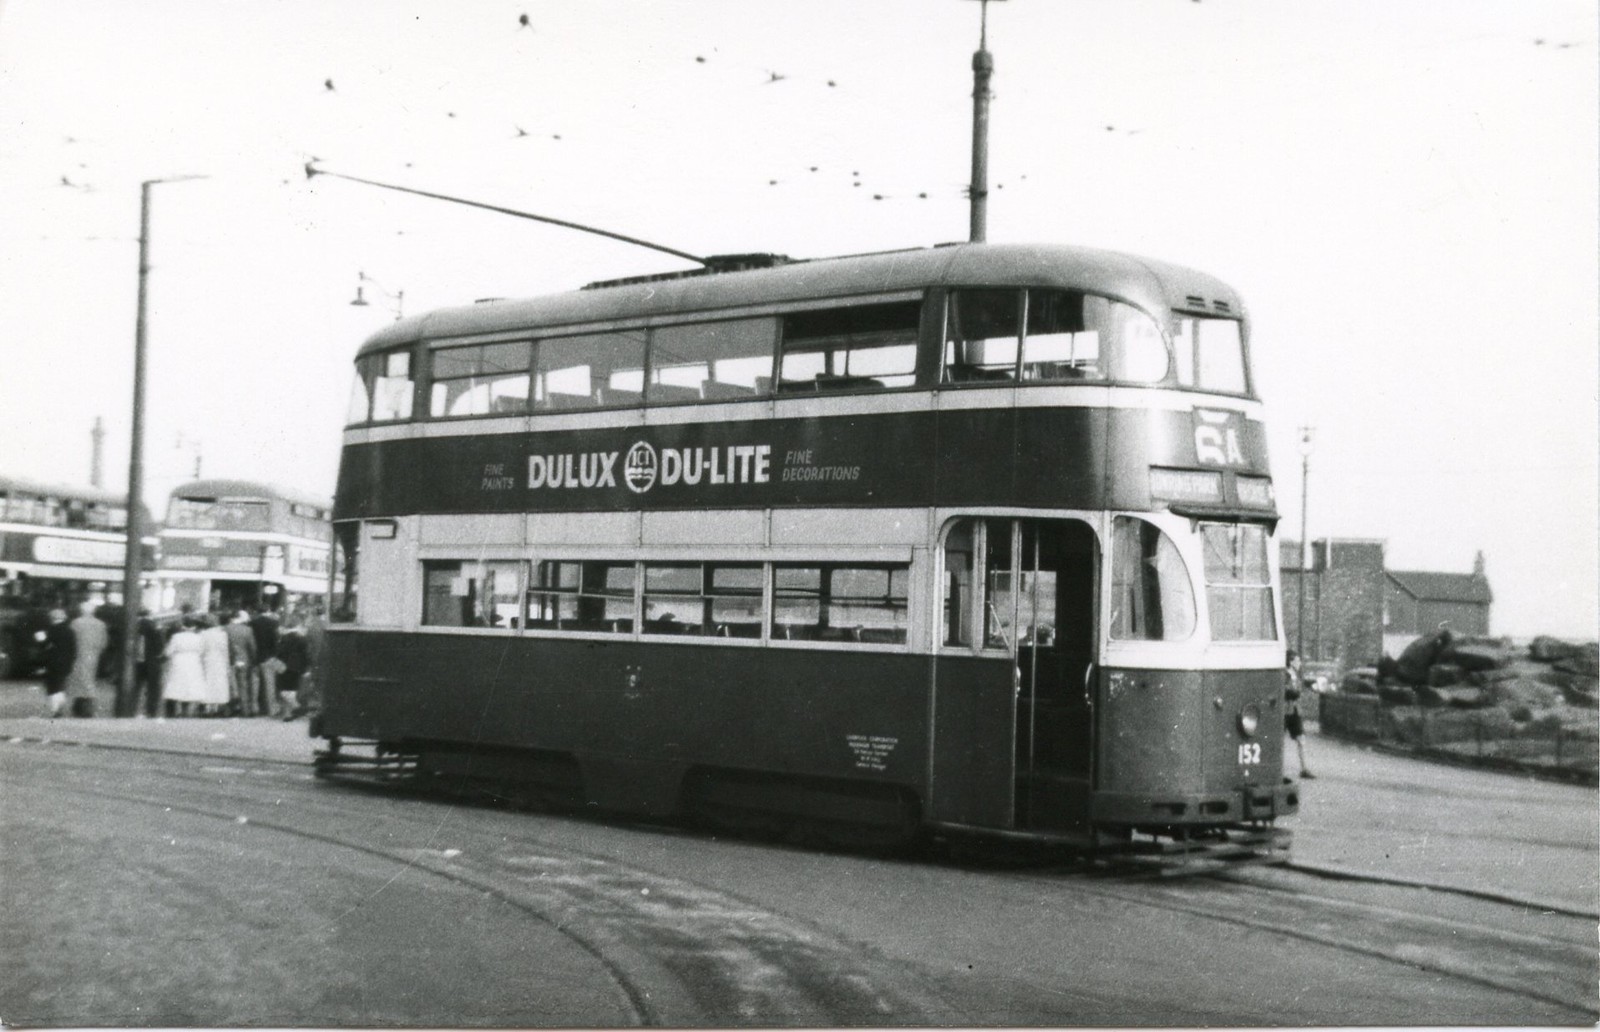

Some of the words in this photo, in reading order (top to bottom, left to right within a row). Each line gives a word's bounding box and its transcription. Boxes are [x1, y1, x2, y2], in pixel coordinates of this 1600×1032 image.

[785, 448, 813, 464] FINE
[484, 463, 505, 476] FINE
[528, 451, 619, 489] DULUX
[631, 450, 650, 467] ICI
[661, 445, 771, 486] DU-LITE
[782, 466, 861, 482] DECORATIONS
[481, 477, 515, 491] PAINTS
[1238, 743, 1261, 765] 152
